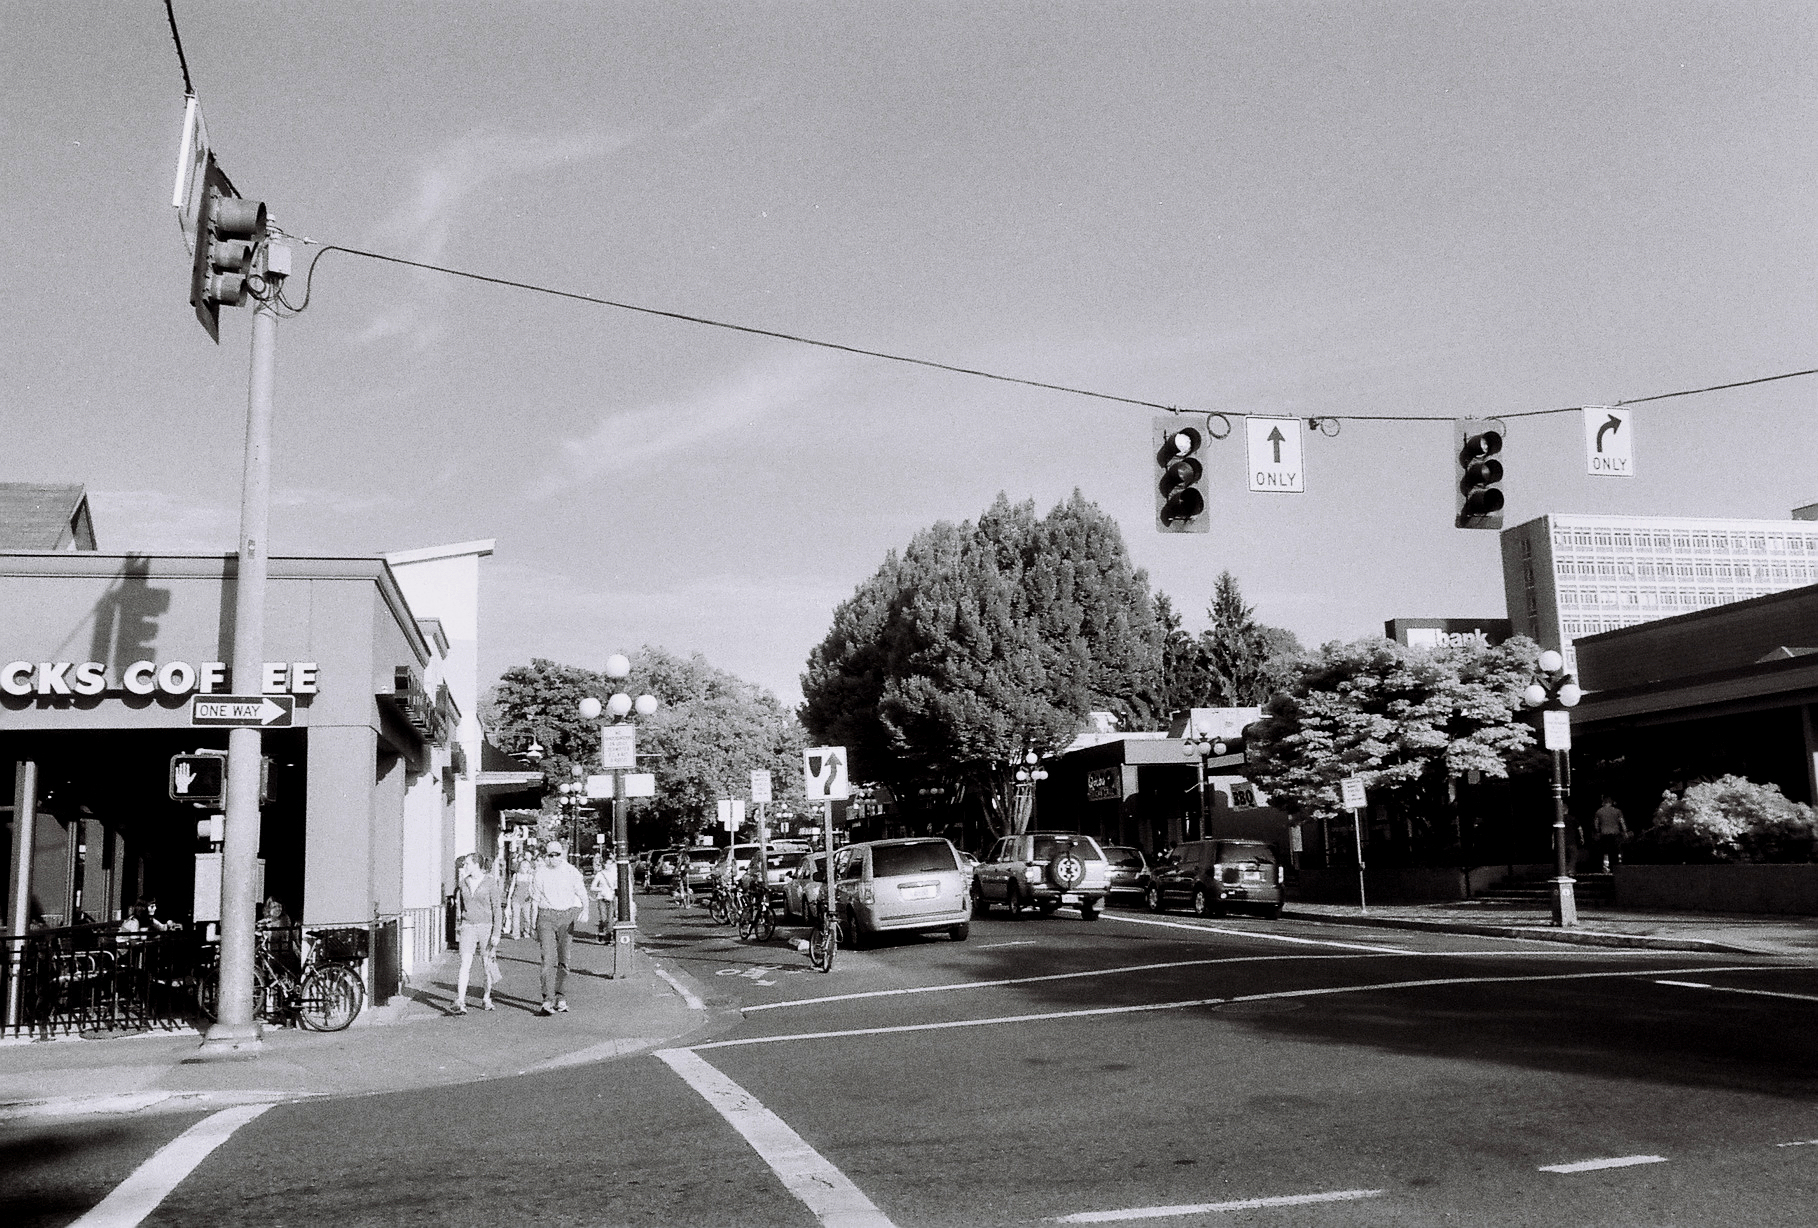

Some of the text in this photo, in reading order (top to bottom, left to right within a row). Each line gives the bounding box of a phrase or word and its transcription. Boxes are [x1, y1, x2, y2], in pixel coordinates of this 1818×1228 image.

[1592, 456, 1627, 471] ONLY
[1256, 471, 1297, 487] ONLY
[1435, 627, 1492, 648] bank
[123, 659, 319, 695] COFEE
[199, 704, 261, 718] ONE WAY
[1231, 789, 1256, 807] BBQ
